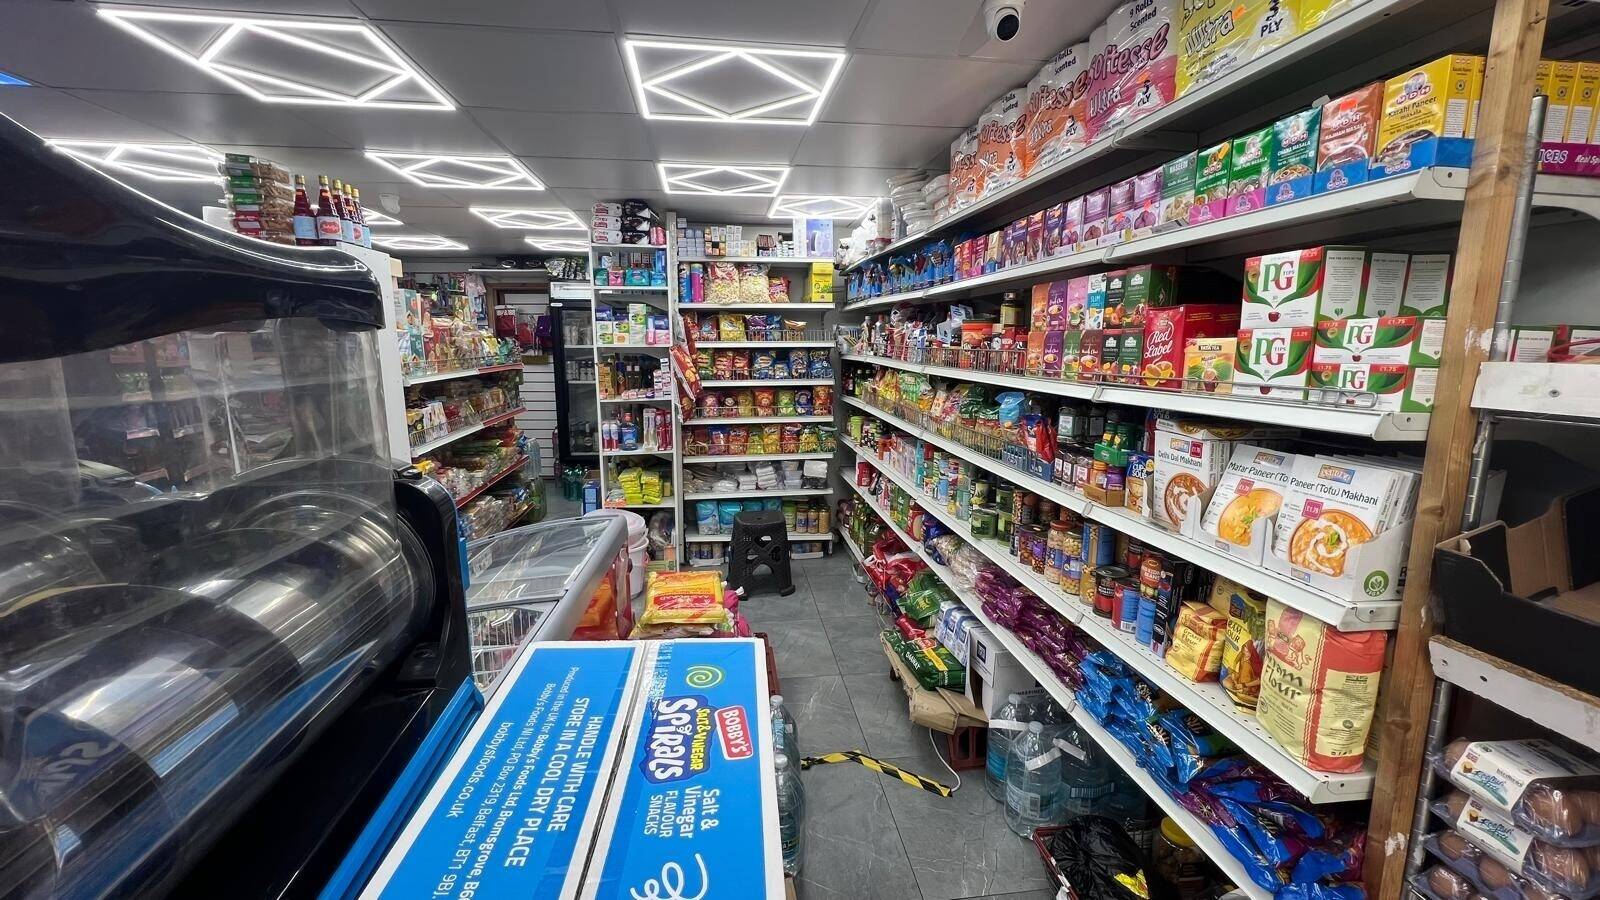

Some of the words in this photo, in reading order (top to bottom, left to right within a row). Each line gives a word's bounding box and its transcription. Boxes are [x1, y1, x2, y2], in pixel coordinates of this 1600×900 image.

[1130, 7, 1157, 31] Scented
[1261, 18, 1283, 37] PLY
[1030, 70, 1088, 113] oftesse
[1281, 131, 1309, 148] MDH
[1262, 261, 1294, 292] PG
[1346, 325, 1372, 344] PG
[1144, 340, 1173, 358] Label
[1253, 337, 1285, 365] PG
[1342, 370, 1365, 389] PG
[1170, 453, 1179, 462] Dal
[1179, 456, 1203, 467] Makhani
[1228, 461, 1248, 473] Matar
[1248, 466, 1275, 479] Paneer
[1290, 477, 1315, 491] Paneer
[1315, 482, 1340, 497] (Tofu)
[1340, 489, 1379, 505] Makhani
[1227, 629, 1240, 643] OUR
[1228, 620, 1242, 633] RAM
[1266, 664, 1302, 699] Flour
[527, 706, 545, 727] Foods
[565, 697, 590, 727] STORE
[559, 730, 578, 741] IN
[576, 716, 604, 759] HANDLE
[722, 708, 749, 753] BOBBY'S
[506, 752, 522, 765] PO
[526, 734, 550, 764] Bobby's
[555, 743, 572, 752] A
[446, 720, 516, 818] bobbysfoods.co.uk
[499, 765, 515, 780] Box
[513, 764, 535, 791] Foods
[541, 754, 568, 785] COOL
[562, 761, 588, 793] WITH
[481, 782, 506, 806] 2319,
[502, 792, 522, 810] Ltd,
[529, 788, 555, 814] DRY
[702, 788, 720, 816] Salt
[547, 796, 577, 832] CARE
[644, 795, 663, 836] SNACKS
[658, 790, 679, 838] FLAVOUR
[677, 785, 702, 839] Vinegar
[700, 818, 719, 831] &
[459, 808, 493, 846] Belfast,
[466, 810, 513, 879] Bromsgrove,
[504, 817, 543, 867] PLACE
[448, 849, 472, 870] BT1
[459, 881, 480, 900] B6
